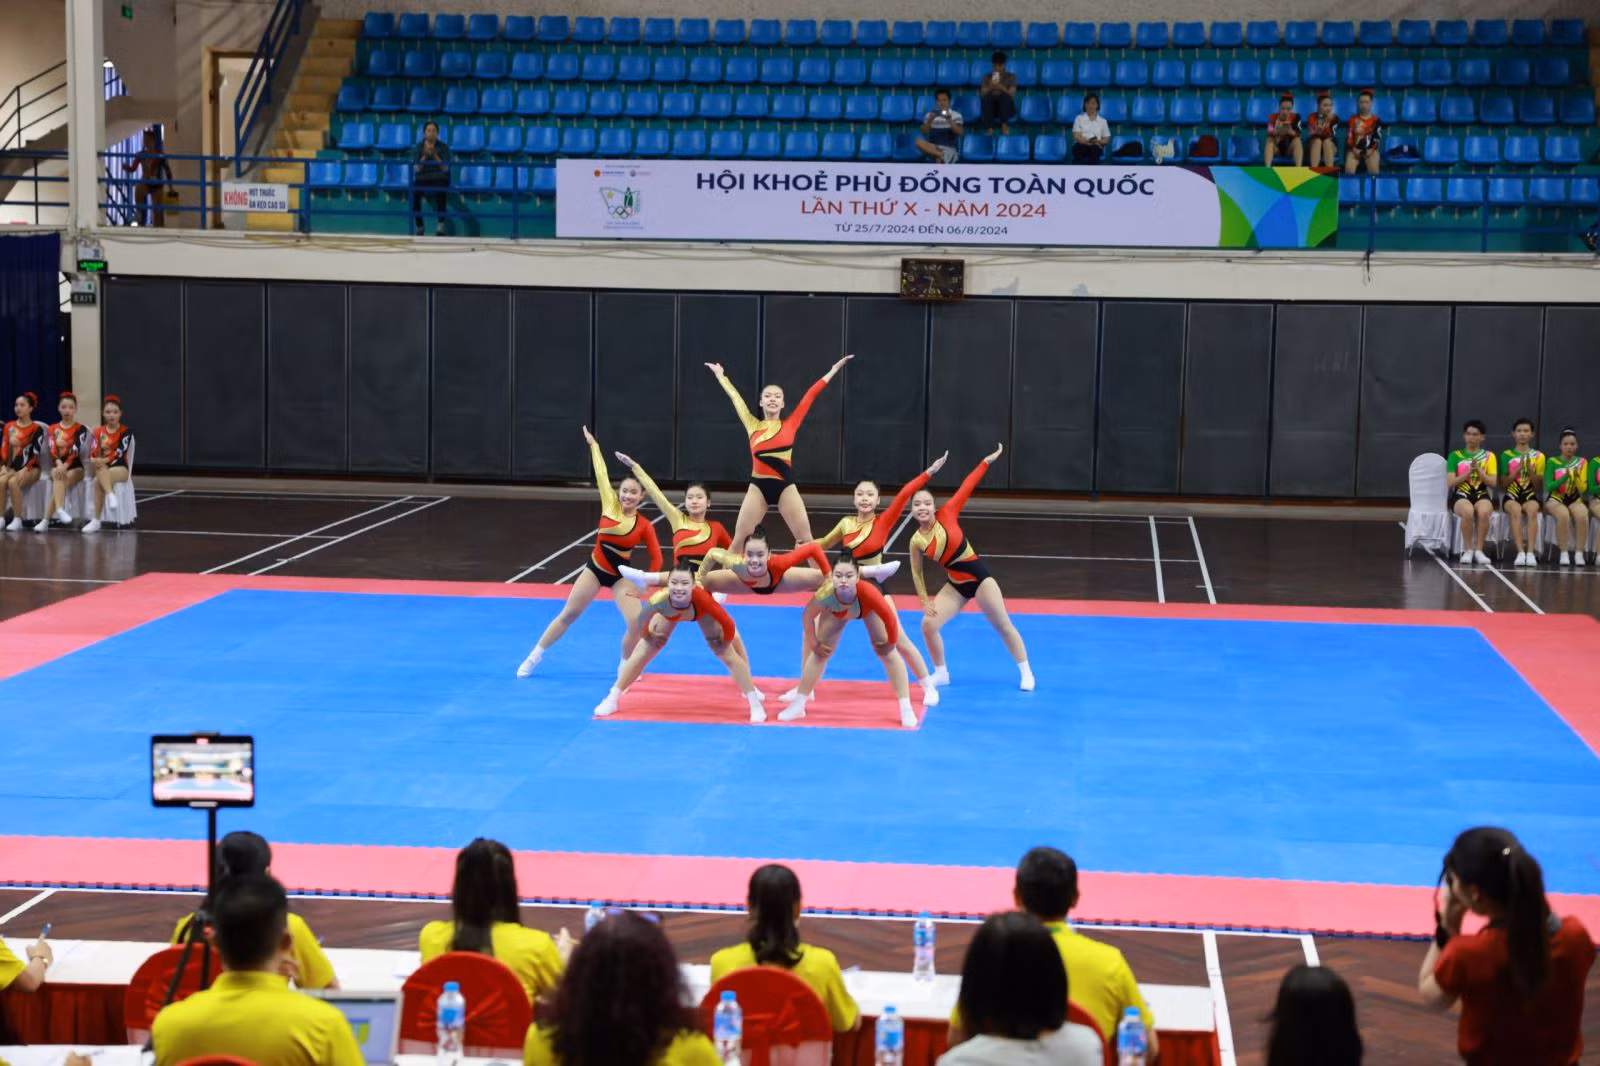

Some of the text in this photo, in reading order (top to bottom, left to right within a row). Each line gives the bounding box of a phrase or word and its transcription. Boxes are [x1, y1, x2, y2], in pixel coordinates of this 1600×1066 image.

[697, 169, 1155, 198] HỘI KHOẺ PHÙ ĐỔNG TOÀN QUỐC
[224, 189, 248, 206] KHÔNG
[801, 196, 843, 215] LẦN
[849, 198, 898, 216] THỨ
[904, 202, 917, 216] X
[938, 199, 989, 217] NĂM
[995, 203, 1047, 218] 2024
[835, 222, 1008, 235] TỪ 25/7/2024 ĐẾN 06/8/2024
